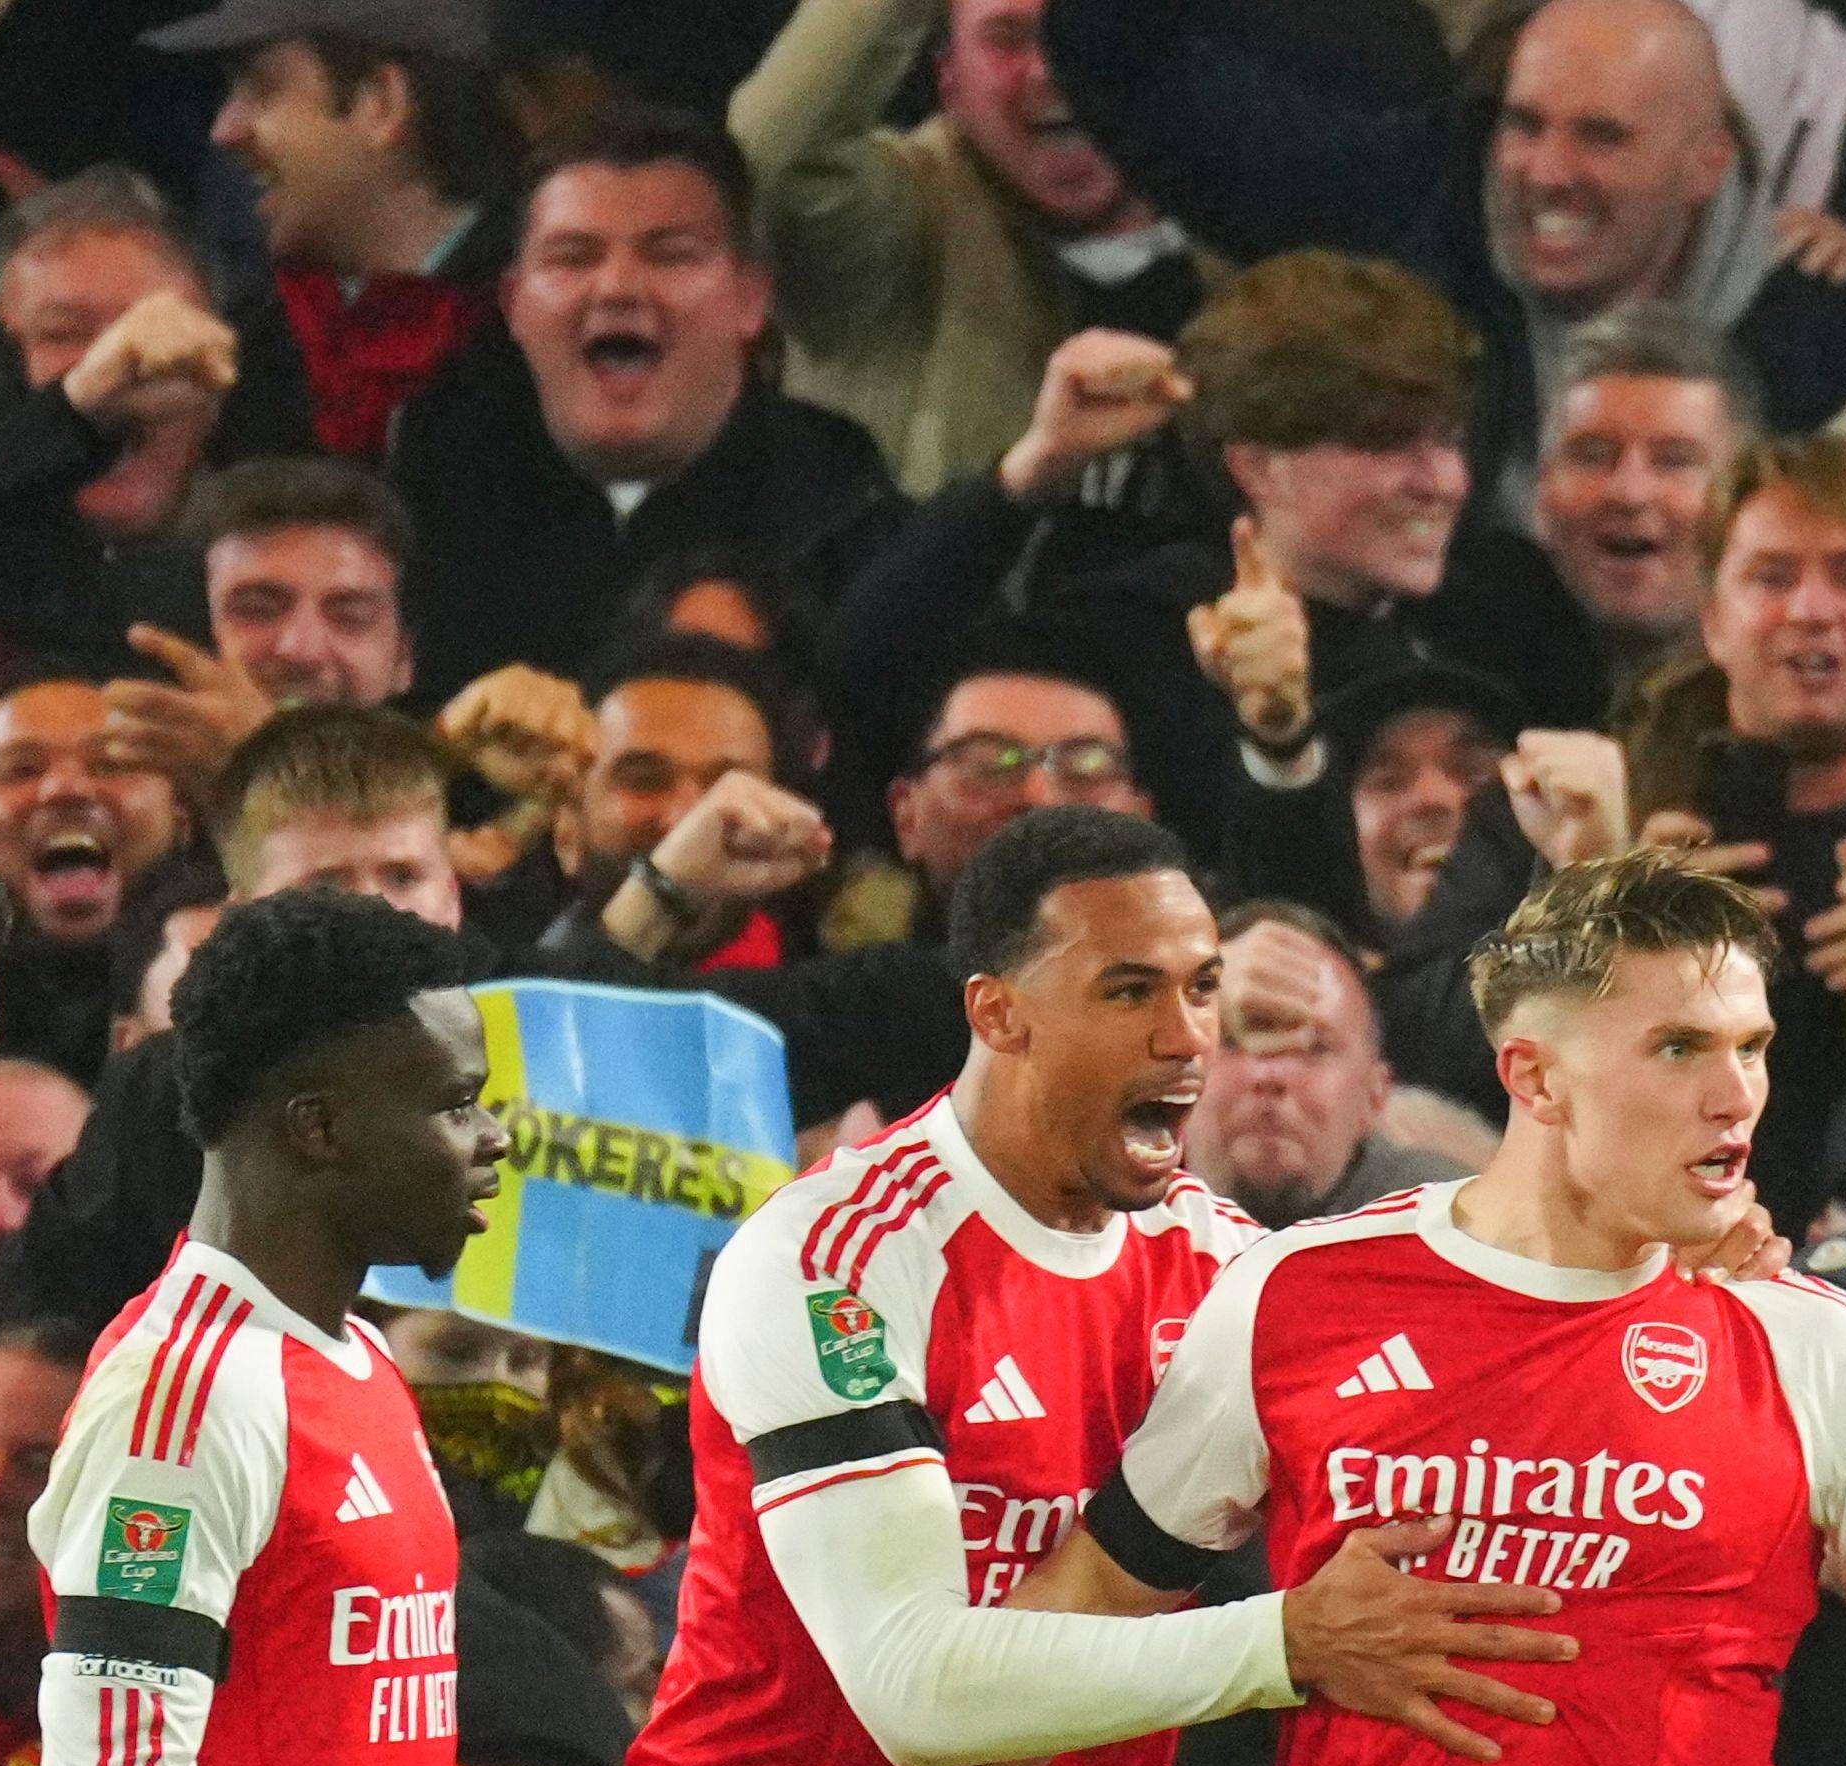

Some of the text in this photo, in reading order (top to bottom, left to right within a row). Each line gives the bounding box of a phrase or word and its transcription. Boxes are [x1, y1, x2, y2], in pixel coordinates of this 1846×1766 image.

[1326, 1438, 1706, 1531] Emirates
[1445, 1517, 1630, 1590] BETTER
[329, 1572, 457, 1666] Emira
